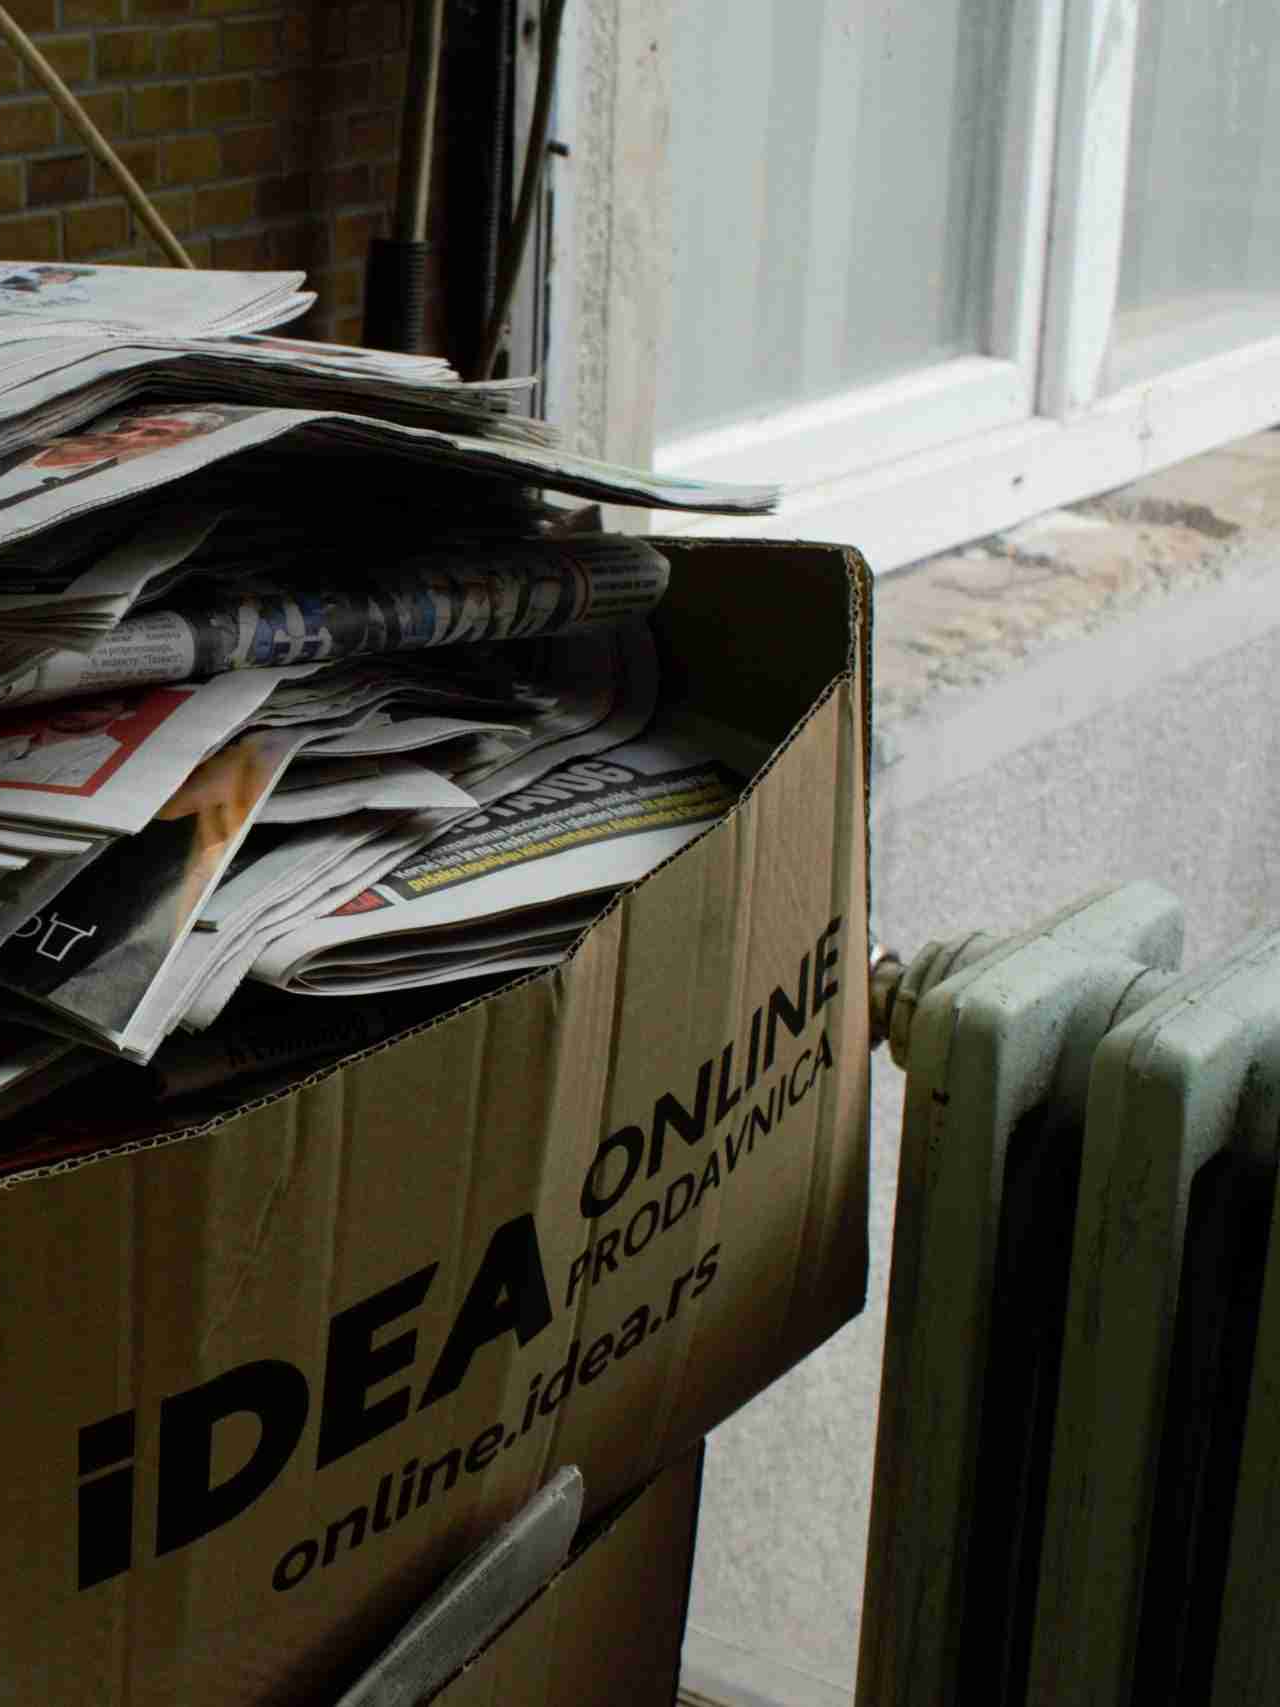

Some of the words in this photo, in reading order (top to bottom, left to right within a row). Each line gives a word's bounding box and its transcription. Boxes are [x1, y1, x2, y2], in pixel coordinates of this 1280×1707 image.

[567, 1029, 833, 1307] PRODAVNICA
[581, 915, 842, 1220] ONLINE
[271, 1243, 721, 1593] online.idea.rs
